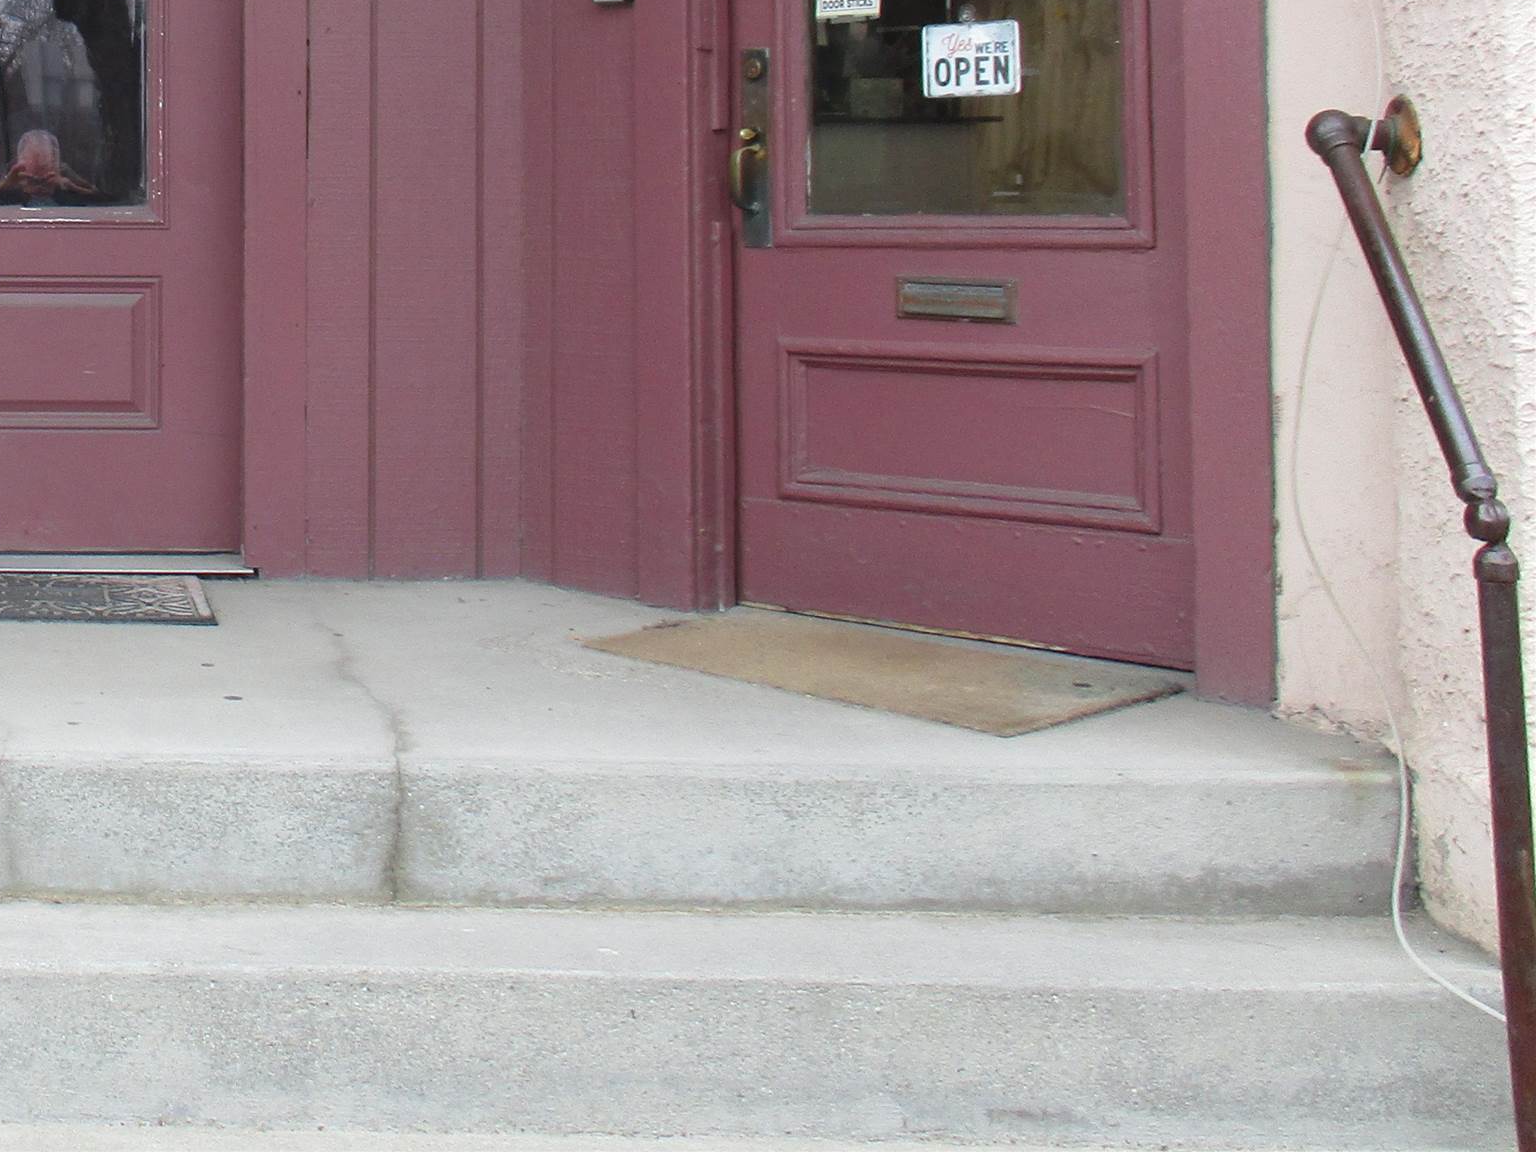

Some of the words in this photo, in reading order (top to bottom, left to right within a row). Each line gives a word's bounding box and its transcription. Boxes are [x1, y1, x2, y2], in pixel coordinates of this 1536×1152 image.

[822, 0, 845, 9] DOOR
[942, 32, 973, 59] Yes
[934, 54, 1010, 87] OPEN
